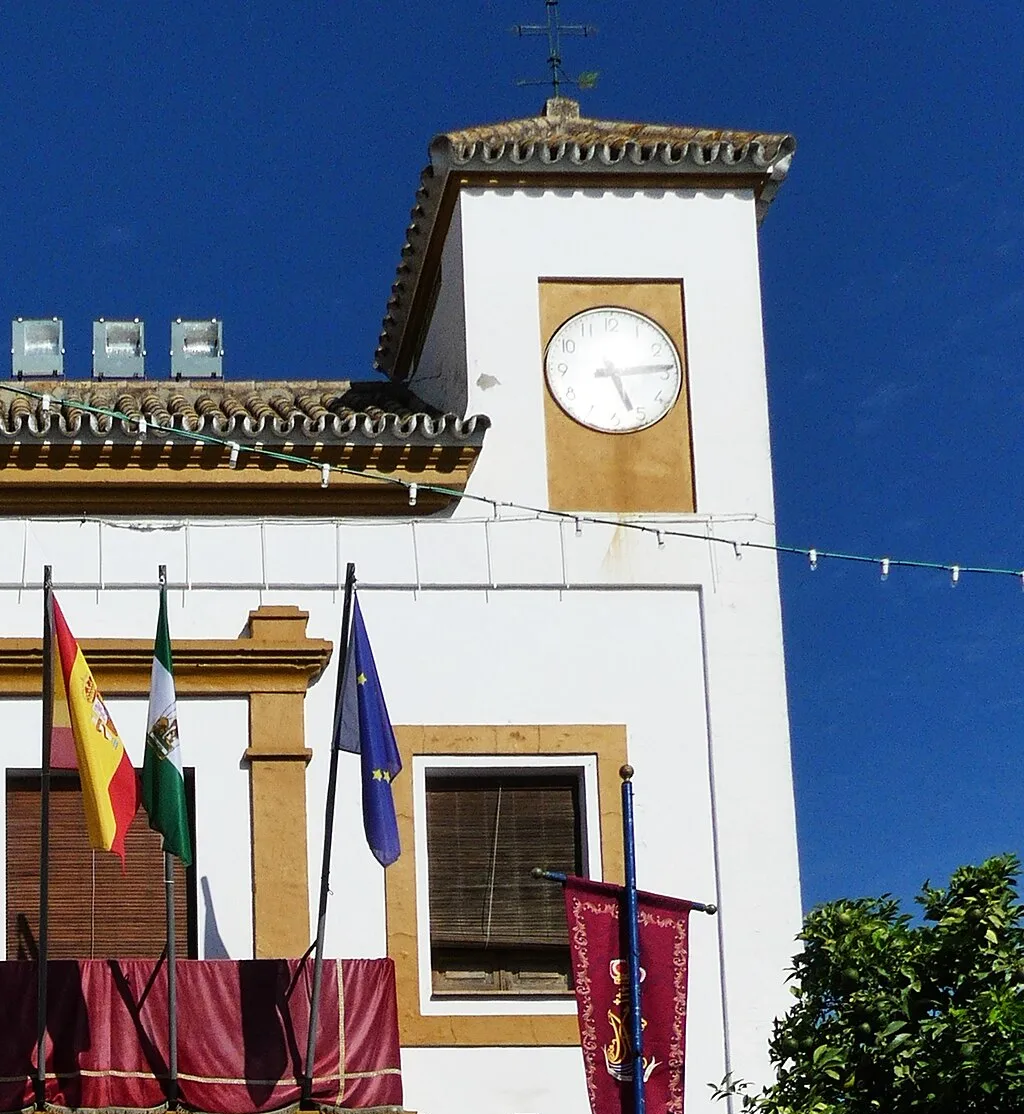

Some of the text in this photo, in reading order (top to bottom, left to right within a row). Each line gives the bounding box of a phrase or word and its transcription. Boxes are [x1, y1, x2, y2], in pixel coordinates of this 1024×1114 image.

[581, 322, 593, 337] 11
[604, 317, 619, 333] 12
[562, 338, 576, 354] 10
[650, 342, 662, 358] 2
[557, 362, 569, 377] 9
[565, 386, 576, 401] 8
[654, 389, 663, 404] 4
[635, 406, 647, 422] 5
